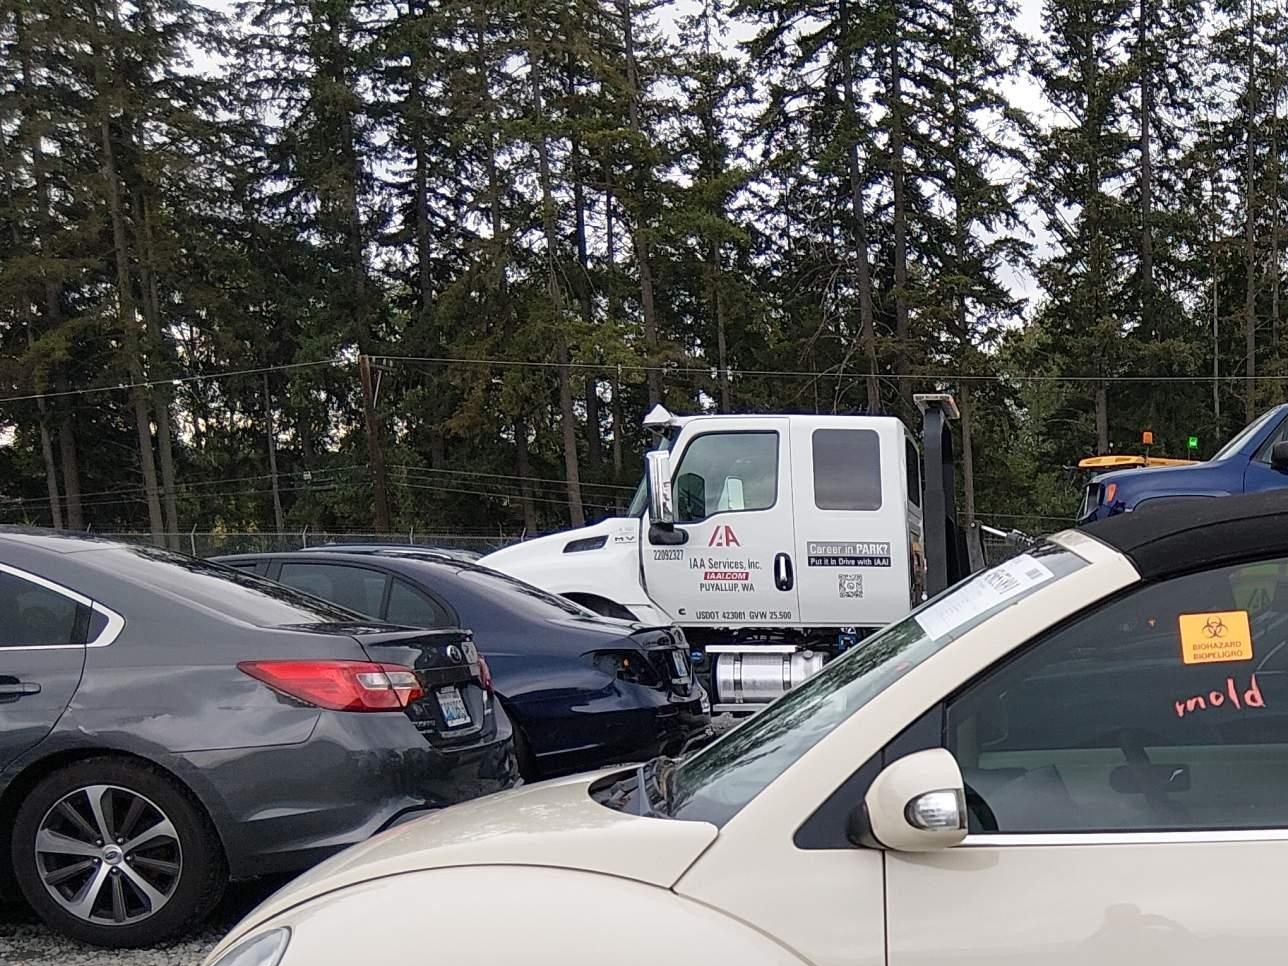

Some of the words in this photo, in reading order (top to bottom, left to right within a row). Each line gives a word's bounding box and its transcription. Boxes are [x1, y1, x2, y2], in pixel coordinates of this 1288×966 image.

[809, 543, 842, 554] Career
[845, 543, 854, 554] in
[856, 543, 888, 555] PARK?
[653, 549, 684, 561] 22092327
[689, 557, 706, 570] IAA
[708, 557, 747, 570] Services,
[747, 559, 762, 570] Inc.
[810, 557, 822, 566] Put
[838, 557, 855, 566] Drive
[857, 557, 872, 566] with
[699, 582, 740, 592] PUYALLUP,
[741, 583, 755, 592] WA
[695, 611, 719, 620] USDOT
[749, 611, 767, 620] GVW
[1192, 641, 1242, 651] BIOHAZARD
[1193, 649, 1243, 660] BIOPELIGRO
[1174, 673, 1267, 718] mold
